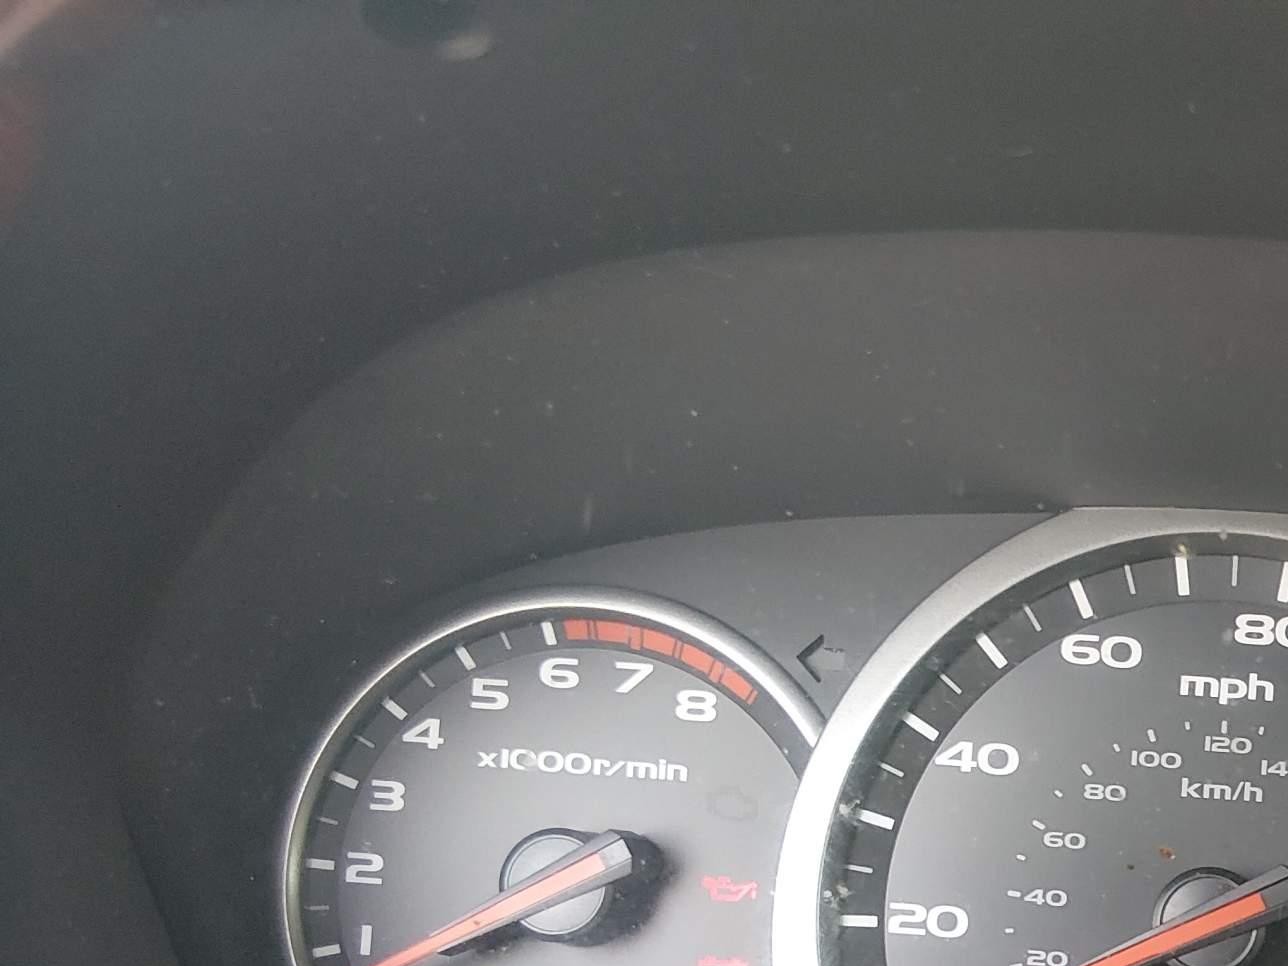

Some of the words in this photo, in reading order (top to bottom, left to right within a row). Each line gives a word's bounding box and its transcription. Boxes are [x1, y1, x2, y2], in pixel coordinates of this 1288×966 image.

[1060, 633, 1142, 669] 60
[539, 657, 580, 689] 6
[615, 661, 654, 693] 7
[1179, 672, 1274, 705] mph
[470, 677, 510, 710] 5
[675, 689, 717, 722] 8
[402, 718, 445, 750] 4
[1204, 735, 1252, 754] 120
[934, 741, 1020, 776] 40
[1131, 750, 1182, 769] 100
[369, 779, 406, 812] 3
[1083, 783, 1126, 802] 80
[1180, 777, 1263, 803] km/h
[1043, 831, 1086, 849] 60
[345, 851, 384, 885] 2
[1023, 889, 1068, 907] 40
[887, 902, 969, 938] 20
[359, 924, 373, 956] 1
